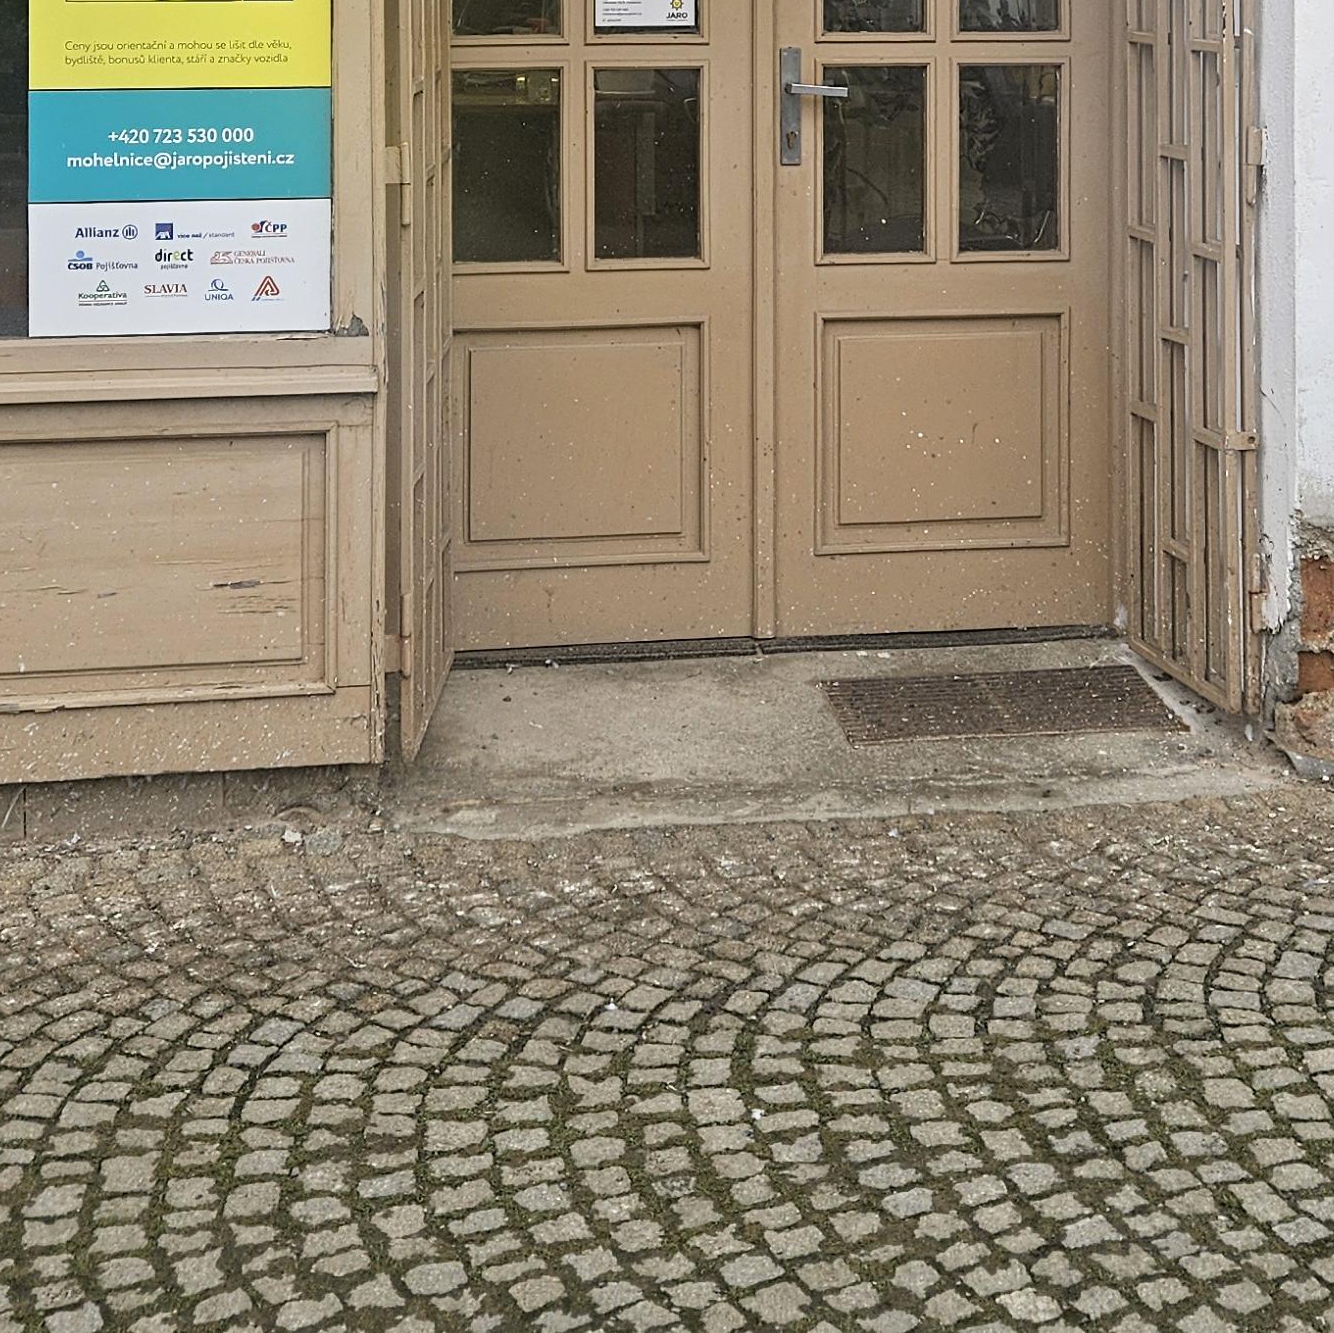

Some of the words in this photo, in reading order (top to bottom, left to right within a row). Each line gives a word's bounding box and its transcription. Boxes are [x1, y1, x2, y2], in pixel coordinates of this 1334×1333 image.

[65, 41, 90, 52] Ceny
[92, 41, 114, 52] jsou
[117, 40, 167, 50] orientační
[178, 41, 213, 50] mohou
[216, 42, 226, 50] se
[229, 40, 246, 49] lišit
[248, 40, 264, 49] dle
[266, 40, 292, 51] věku,
[108, 54, 145, 64] bonusů
[148, 54, 184, 65] klienta,
[218, 54, 252, 65] značky
[255, 54, 288, 63] vozidla
[108, 128, 149, 144] +420
[153, 128, 183, 143] 723
[187, 127, 217, 143] 530
[222, 127, 254, 142] 000
[67, 150, 295, 170] mohelnice@jaropojisteni.cz
[75, 226, 120, 239] Allianz
[265, 222, 288, 233] ČPP
[155, 248, 194, 262] direct
[144, 283, 188, 295] SLAVIA
[78, 292, 127, 300] Kooperativa
[204, 293, 234, 301] UNIQA
